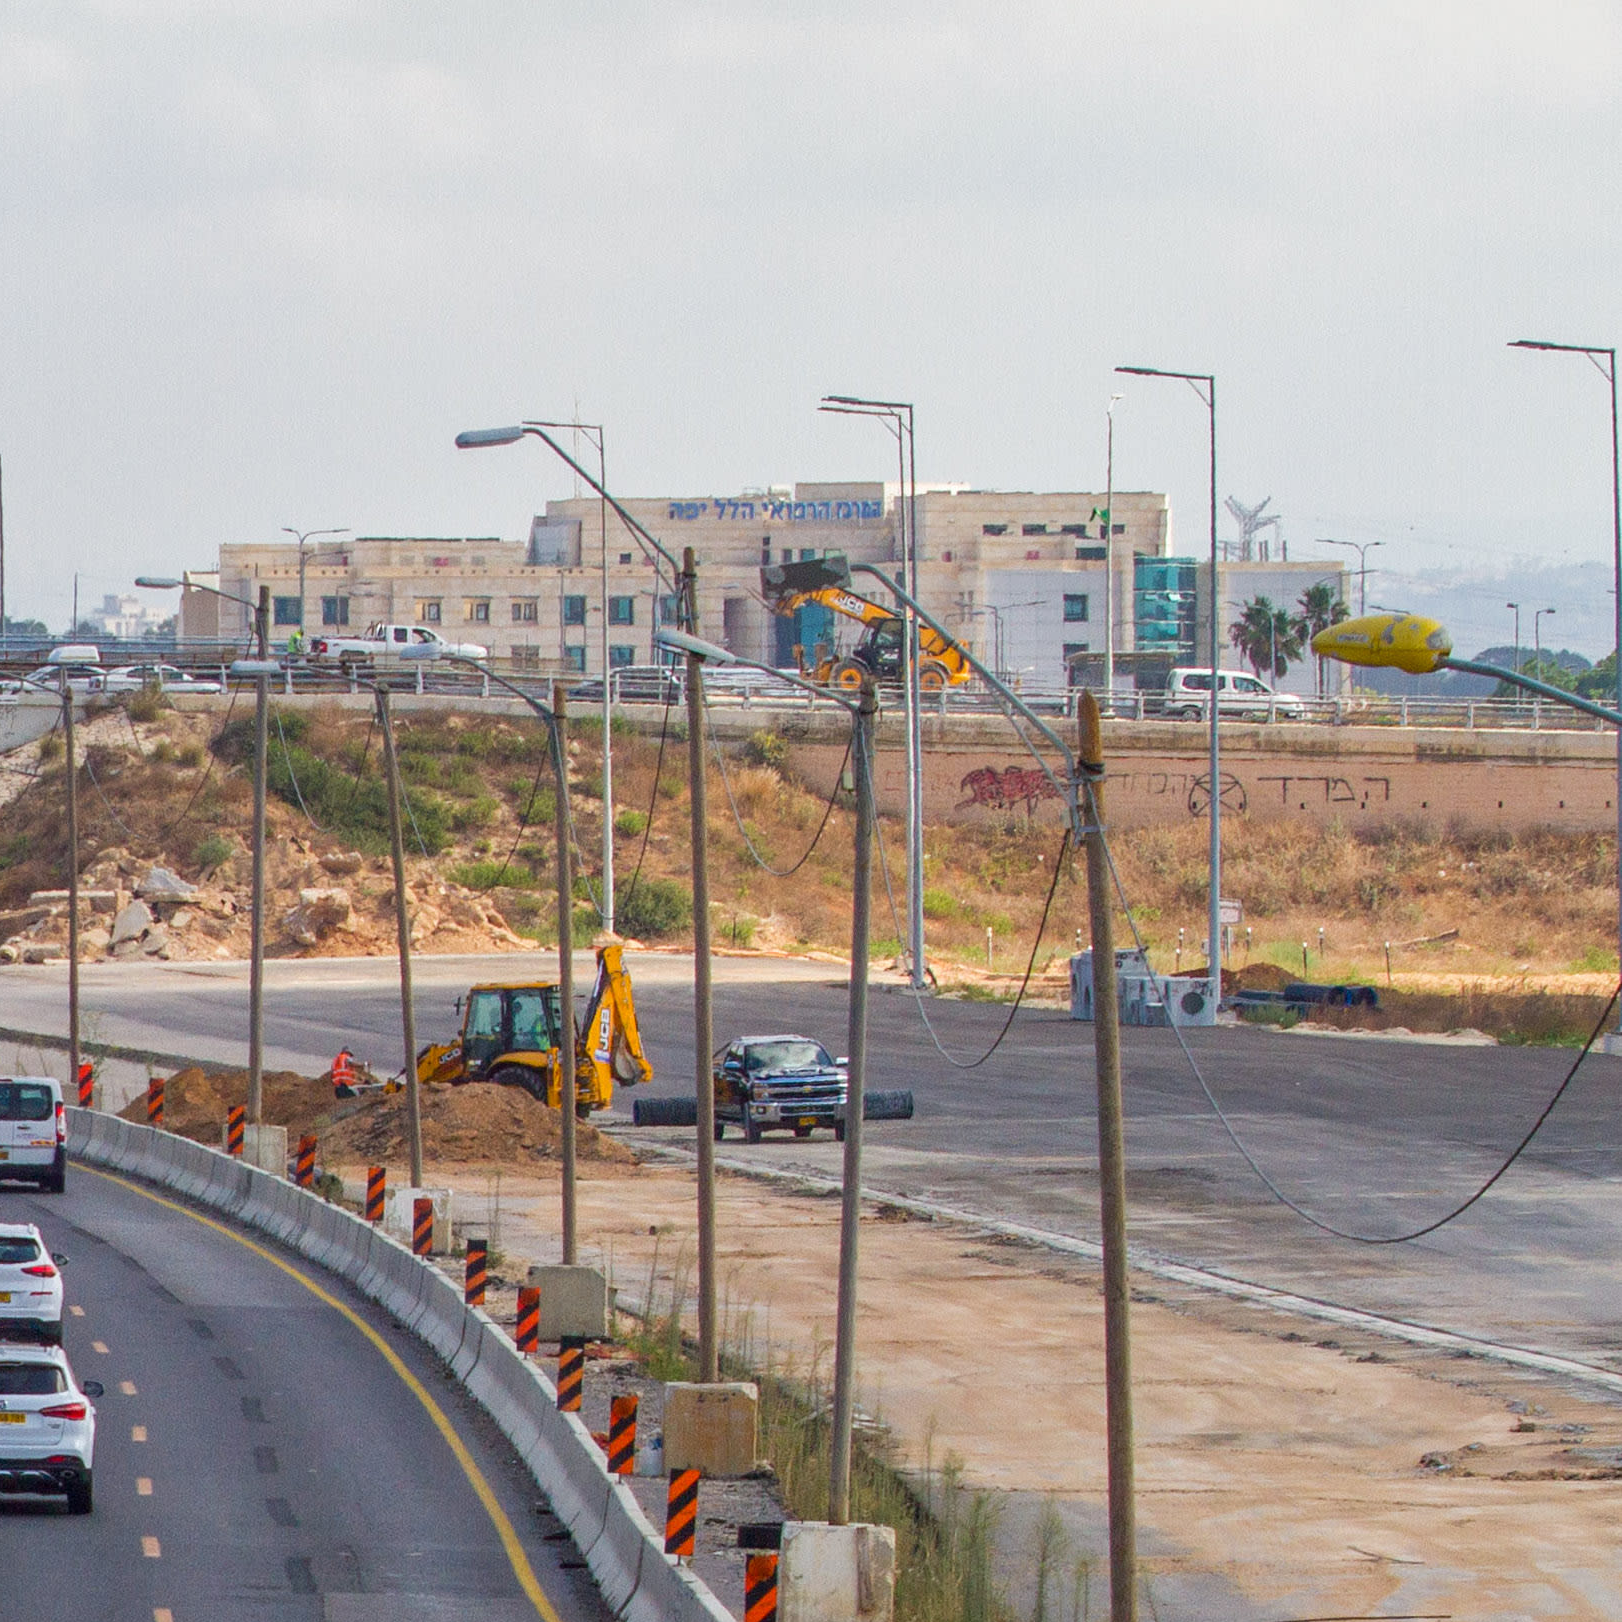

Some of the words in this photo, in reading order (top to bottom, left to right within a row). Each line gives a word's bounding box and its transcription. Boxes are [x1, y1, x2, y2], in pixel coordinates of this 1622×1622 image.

[669, 500, 708, 521] יפה
[714, 497, 755, 521] הלל
[761, 499, 832, 521] הרפואי
[836, 499, 883, 519] המרכז
[600, 1009, 611, 1051] JCB
